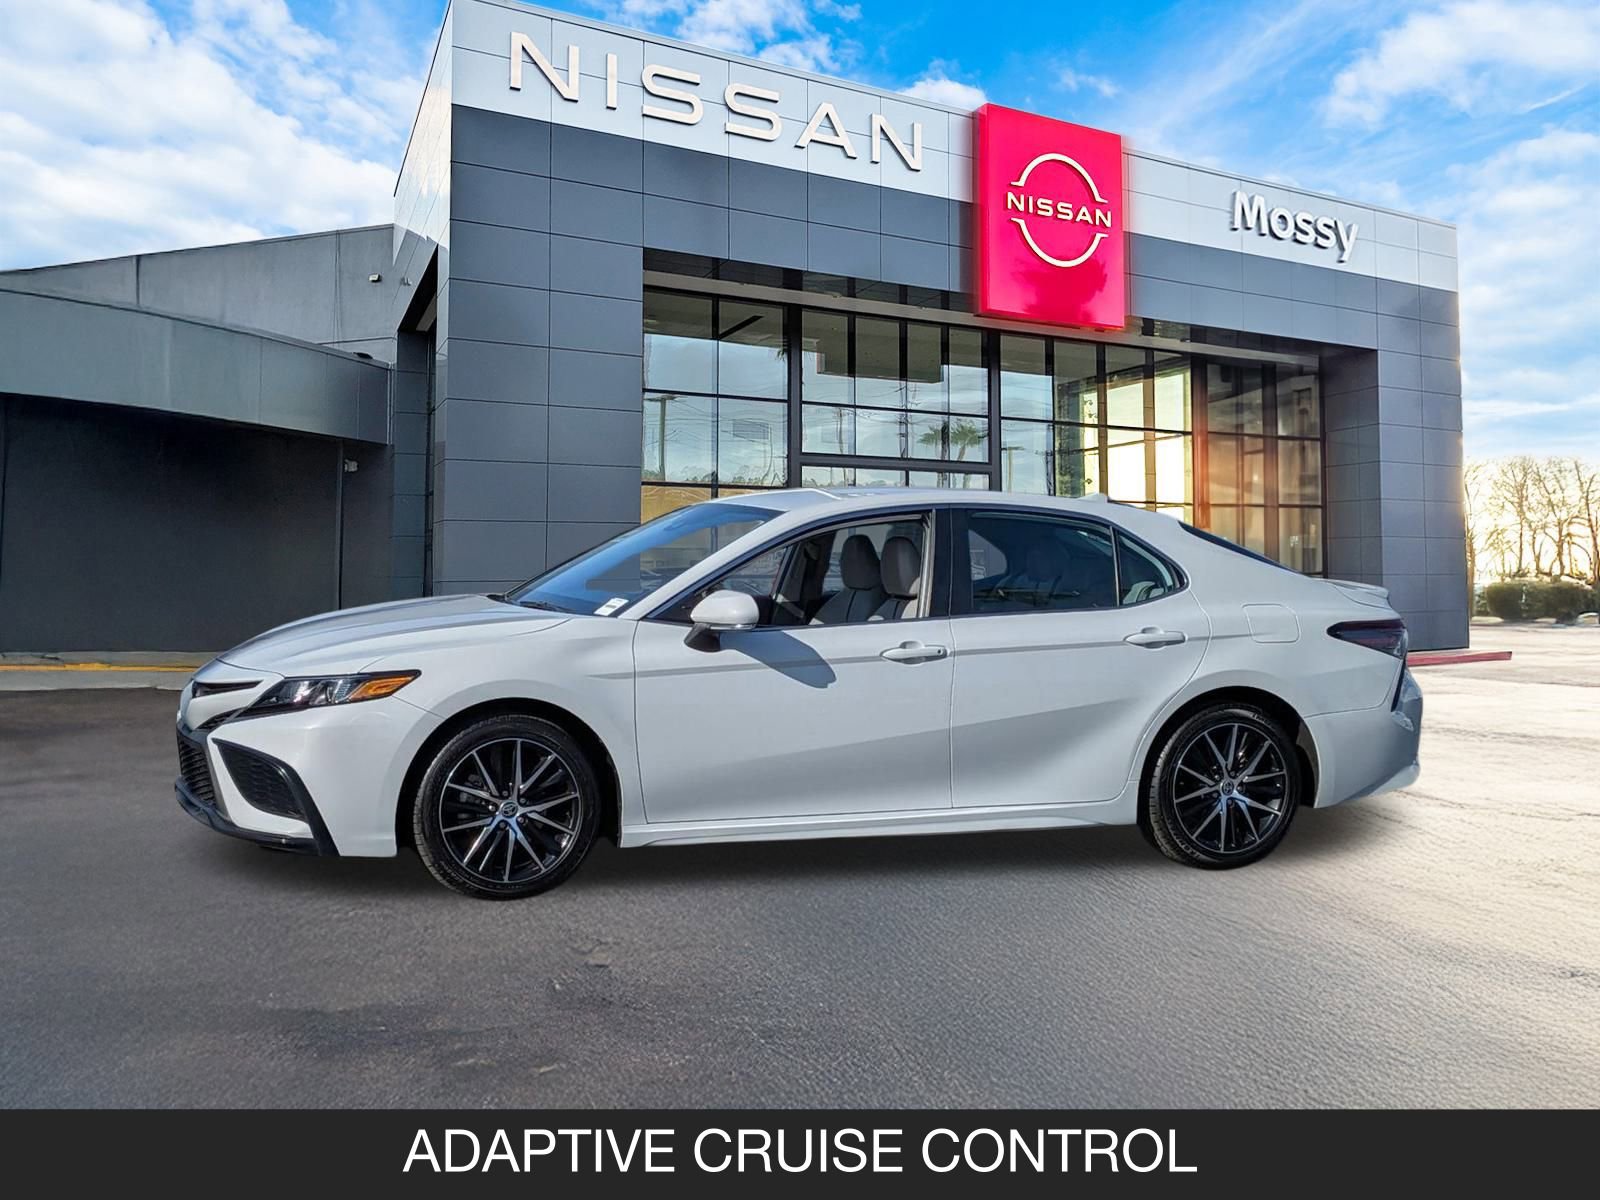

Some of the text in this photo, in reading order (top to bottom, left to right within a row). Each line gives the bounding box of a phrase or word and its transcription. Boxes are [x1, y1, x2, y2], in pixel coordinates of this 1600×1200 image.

[509, 31, 922, 171] NISSAN
[1007, 192, 1112, 228] NISSAN
[1232, 190, 1359, 262] Mossy
